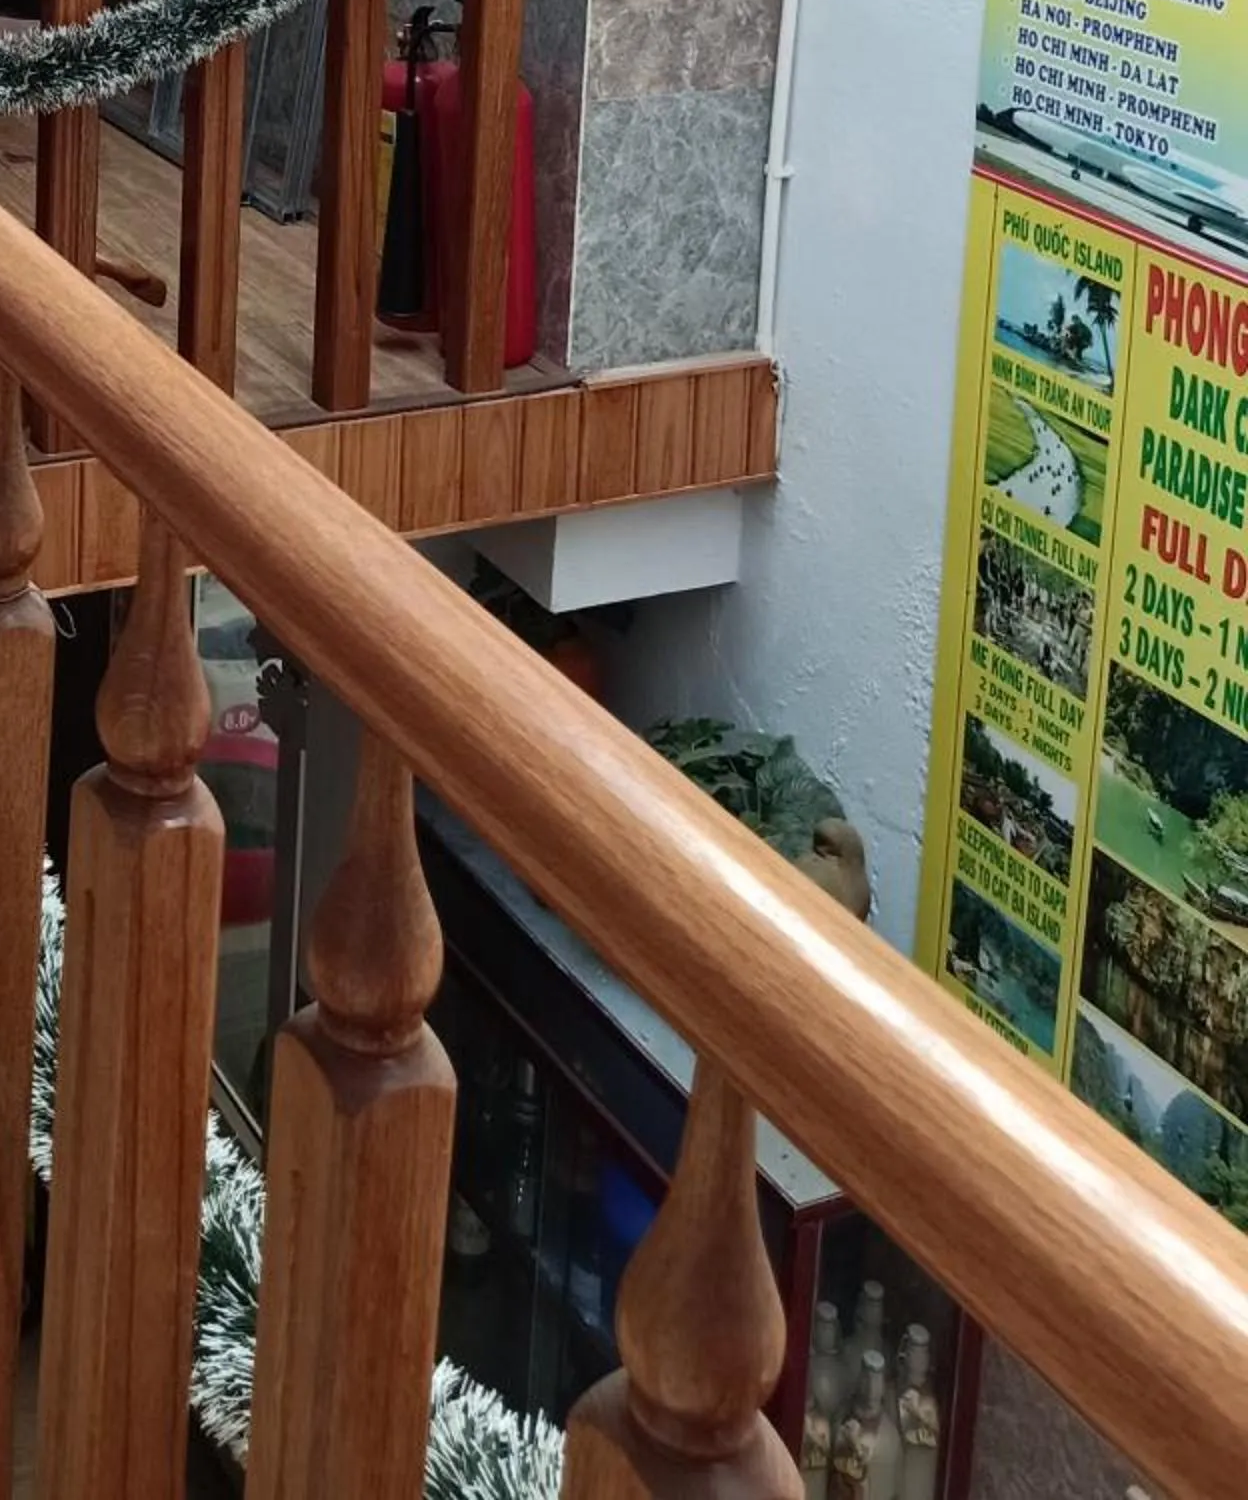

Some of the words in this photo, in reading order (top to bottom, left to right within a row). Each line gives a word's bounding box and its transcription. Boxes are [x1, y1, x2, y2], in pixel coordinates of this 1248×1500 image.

[1018, 28, 1038, 48] HO
[1042, 35, 1066, 57] CHI
[1069, 43, 1109, 73] MINH
[1121, 60, 1141, 81] DA
[1147, 70, 1178, 96] LAT
[1045, 5, 1072, 28] NOI
[1082, 17, 1179, 62] PROMPHENH
[1012, 86, 1032, 107] HO
[1035, 95, 1060, 117] CHI
[1063, 105, 1103, 132] MINH
[1115, 122, 1169, 156] TOKYO
[1015, 56, 1035, 78] HO
[1039, 65, 1064, 87] CHI
[1067, 76, 1106, 102] MINH
[1118, 92, 1216, 141] PROMPHENH
[1073, 240, 1123, 283] ISLAND
[1146, 262, 1248, 377] PHONG
[1169, 365, 1230, 445] DARK
[1140, 426, 1246, 529] PARADISE
[1053, 538, 1074, 573] FULL
[1078, 553, 1098, 585] DAY
[1141, 504, 1211, 585] FULL
[1124, 564, 1137, 605] 2
[1142, 573, 1194, 637] DAYS
[1219, 618, 1229, 657] 1
[992, 653, 1023, 692] KONG
[1026, 675, 1054, 714] FULL
[1060, 698, 1084, 731] DAY
[1120, 617, 1131, 656] 3
[1136, 626, 1184, 689] DAYS
[1204, 668, 1218, 709] 2
[979, 676, 987, 691] 2
[990, 683, 1017, 711] DAYS
[1028, 708, 1033, 724] 1
[1037, 715, 1070, 746] NIGHT
